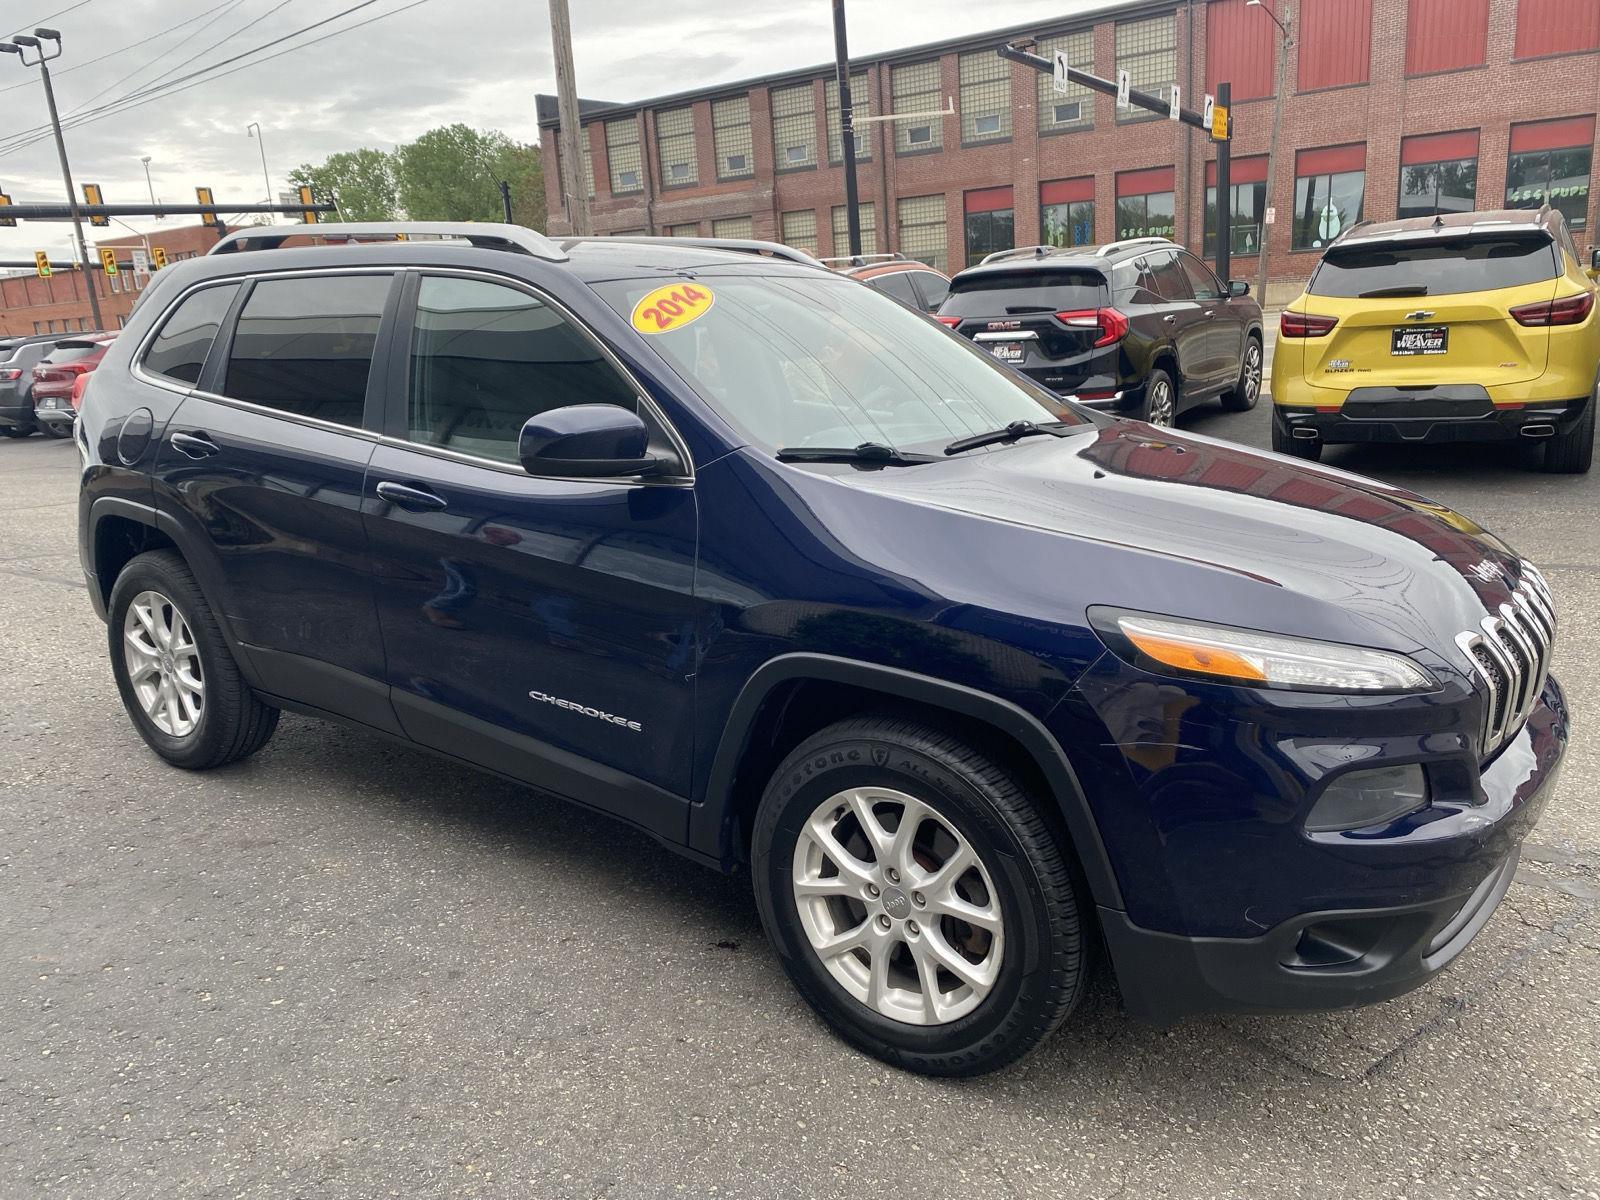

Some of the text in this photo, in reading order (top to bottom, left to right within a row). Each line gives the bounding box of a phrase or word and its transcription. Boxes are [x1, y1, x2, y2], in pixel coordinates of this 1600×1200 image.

[1550, 185, 1588, 198] PUPS
[1149, 226, 1174, 236] PUPS
[642, 285, 706, 329] 2014
[987, 320, 1020, 330] GMC
[1402, 333, 1424, 341] RICK
[1396, 338, 1443, 348] WEAVER
[528, 690, 642, 732] CHEROKEE
